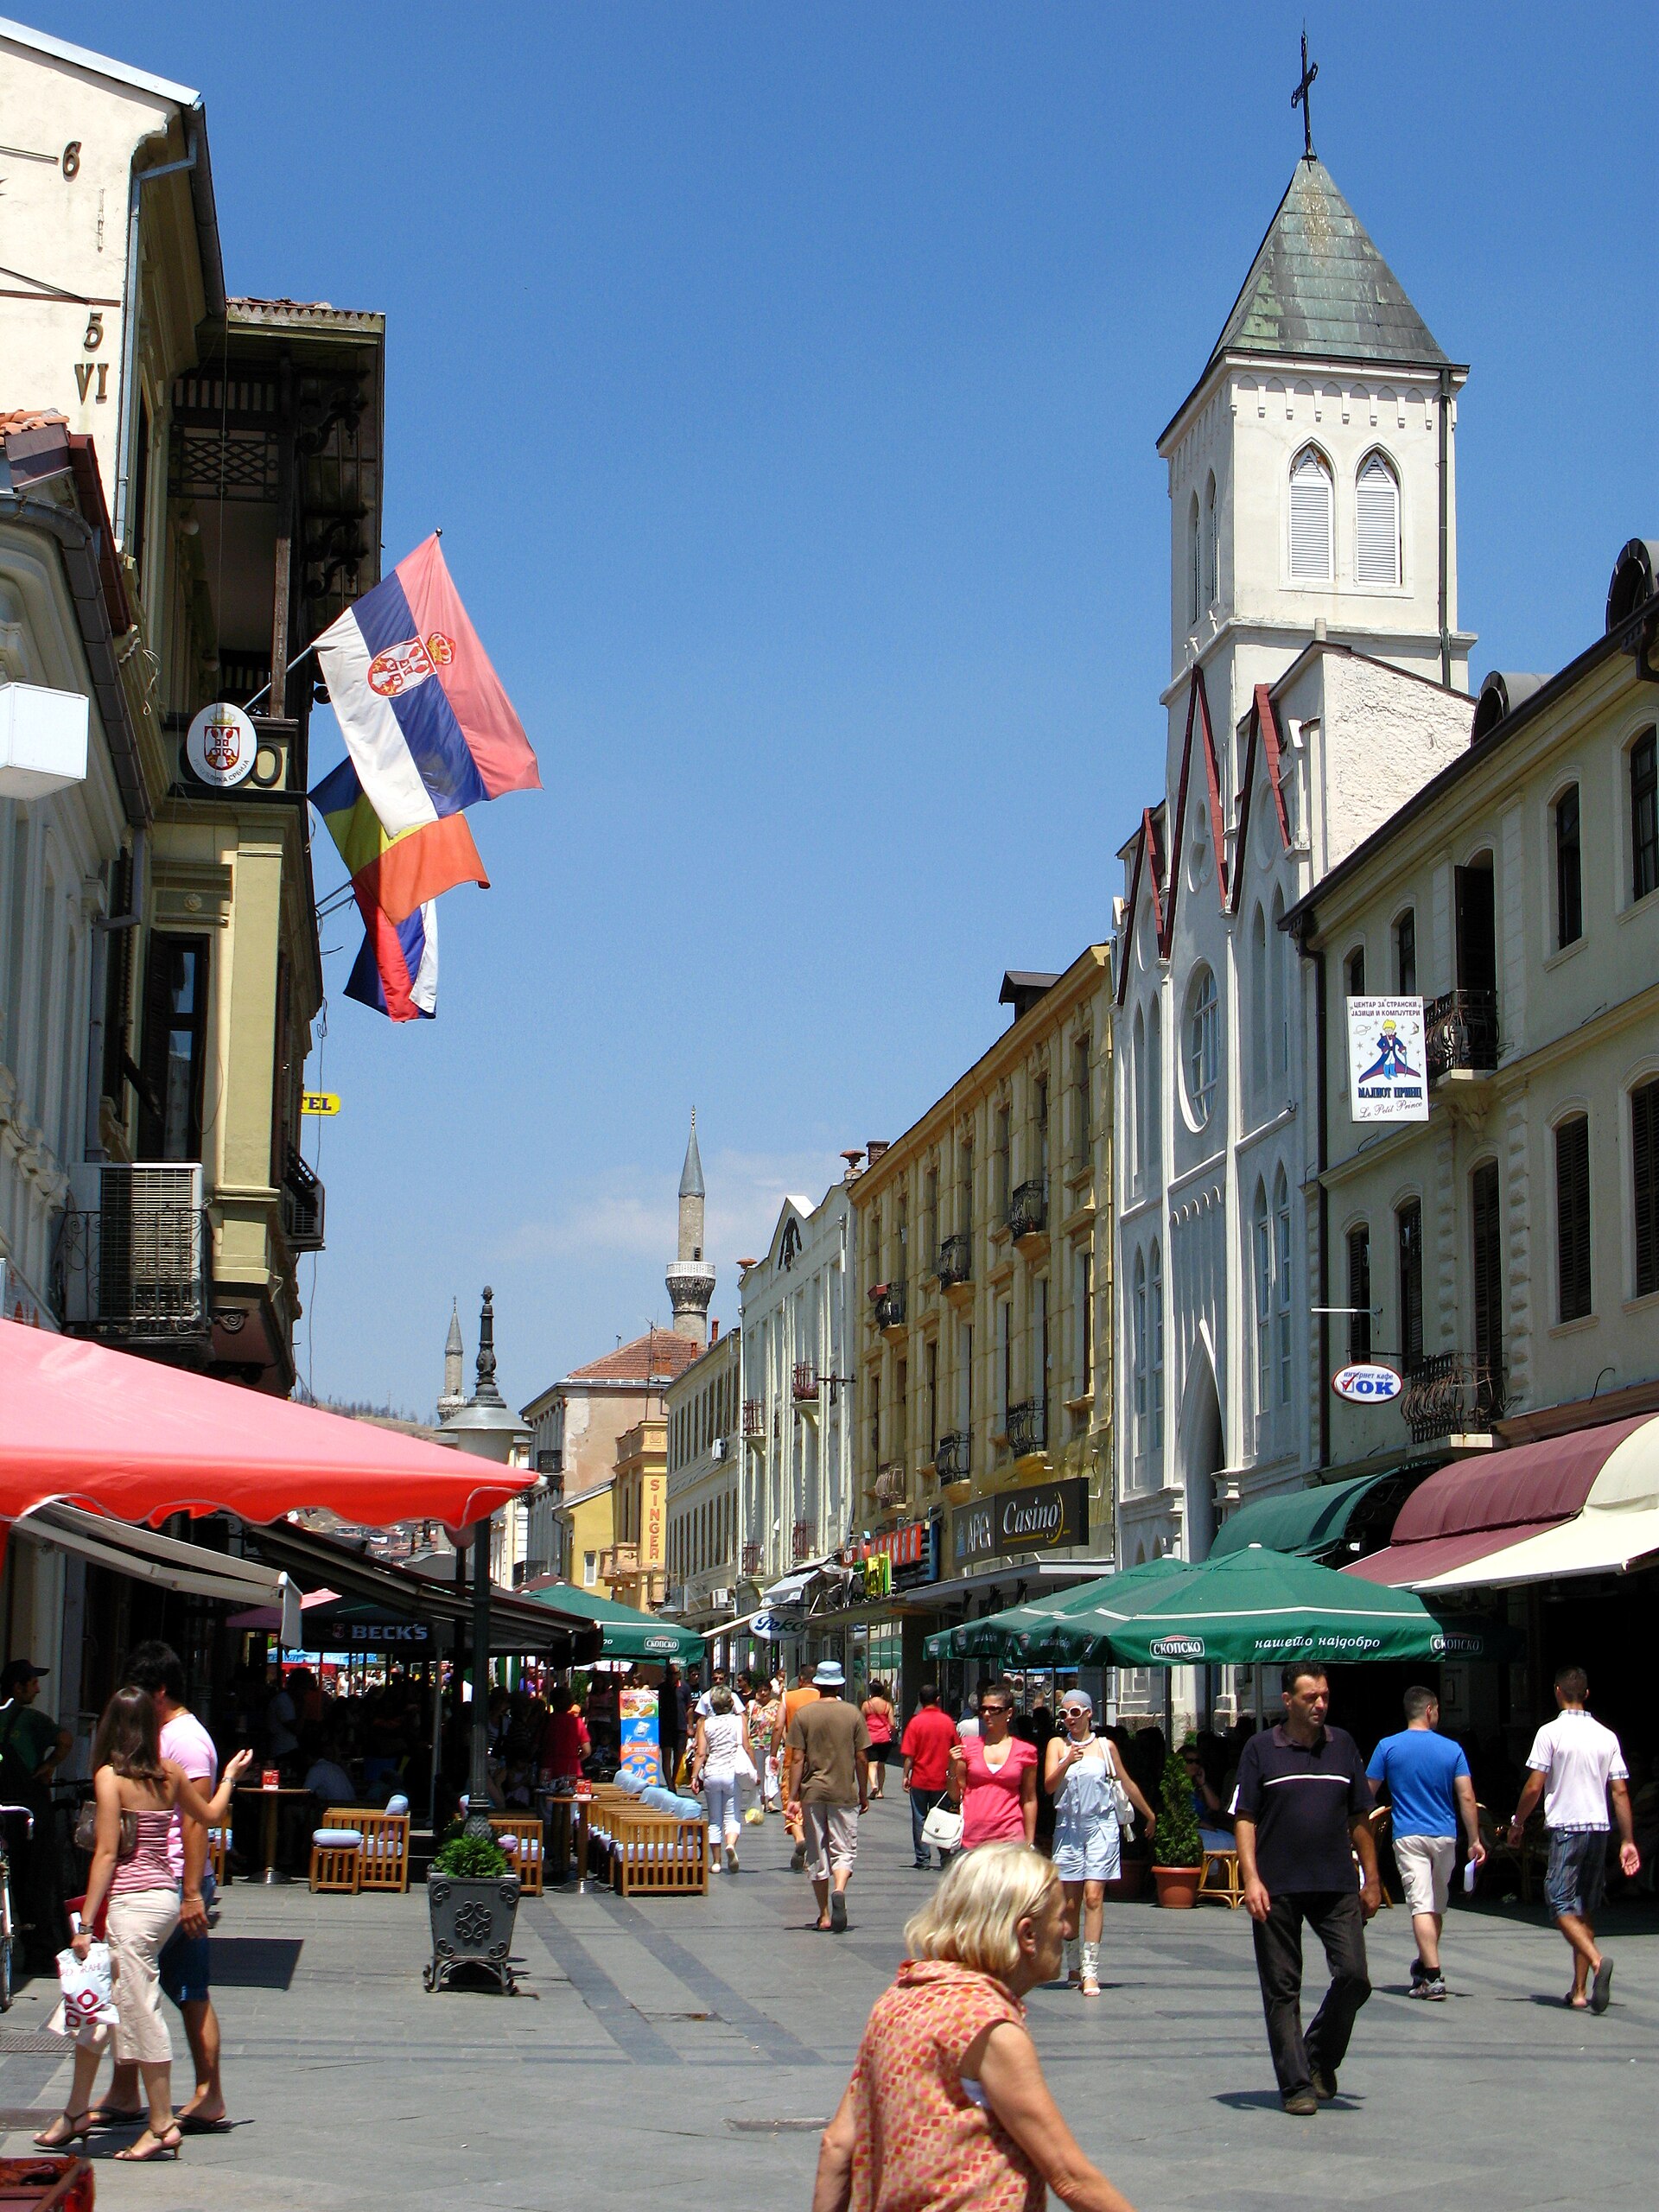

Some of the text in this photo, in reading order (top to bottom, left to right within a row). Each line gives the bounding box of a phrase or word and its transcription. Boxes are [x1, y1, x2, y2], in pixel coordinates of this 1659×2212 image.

[62, 141, 82, 178] 6
[83, 313, 103, 351] 5
[74, 363, 109, 405] VI
[228, 760, 250, 781] СРБИЈА
[1359, 1099, 1423, 1118] Le Petit Prince
[1376, 1372, 1394, 1381] кафе
[649, 1478, 660, 1560] SINGER
[1002, 1497, 1058, 1535] Casino
[352, 1624, 428, 1639] BECK'S
[645, 1640, 677, 1649] СКОПСКО
[1153, 1641, 1201, 1655] СКОПСКО
[1318, 1635, 1381, 1650] најдобро
[1433, 1637, 1480, 1651] СКОПСКО
